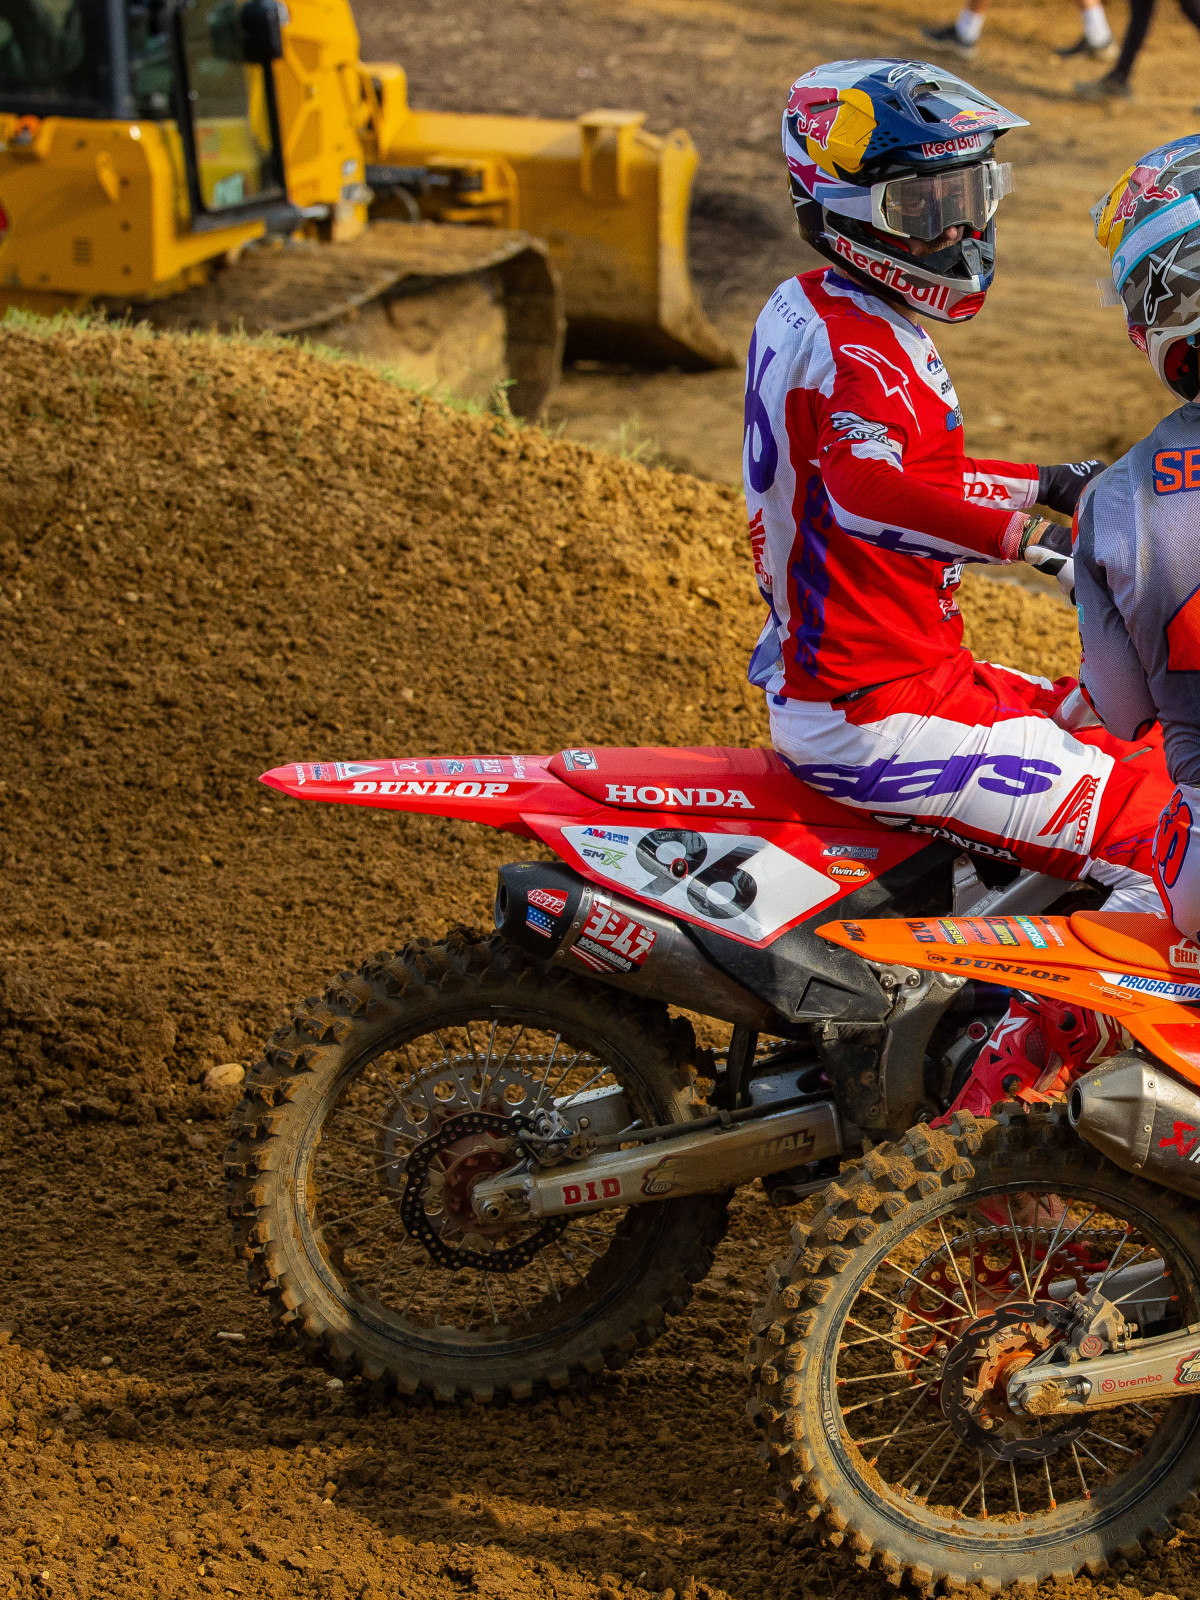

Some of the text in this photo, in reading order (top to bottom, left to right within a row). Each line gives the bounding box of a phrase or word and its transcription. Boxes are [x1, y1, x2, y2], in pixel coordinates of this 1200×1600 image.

[922, 134, 981, 159] Red Bull
[835, 235, 950, 311] Red Bull
[347, 781, 510, 798] DUNLOP
[605, 784, 756, 809] HONDA
[1075, 776, 1101, 846] HONDA
[581, 827, 629, 842] AMA PRO
[909, 823, 1020, 862] HONDA
[582, 848, 626, 870] SMX
[831, 866, 868, 877] Twin Air
[636, 828, 758, 919] 96
[528, 888, 566, 915] RS12
[1019, 920, 1047, 948] MOTOREX
[579, 937, 633, 972] YOSHIMURA
[1174, 948, 1198, 964] SELLE
[951, 956, 1071, 984] DUNLOP
[562, 1178, 621, 1205] D.I.D
[1118, 1373, 1163, 1389] brembo
